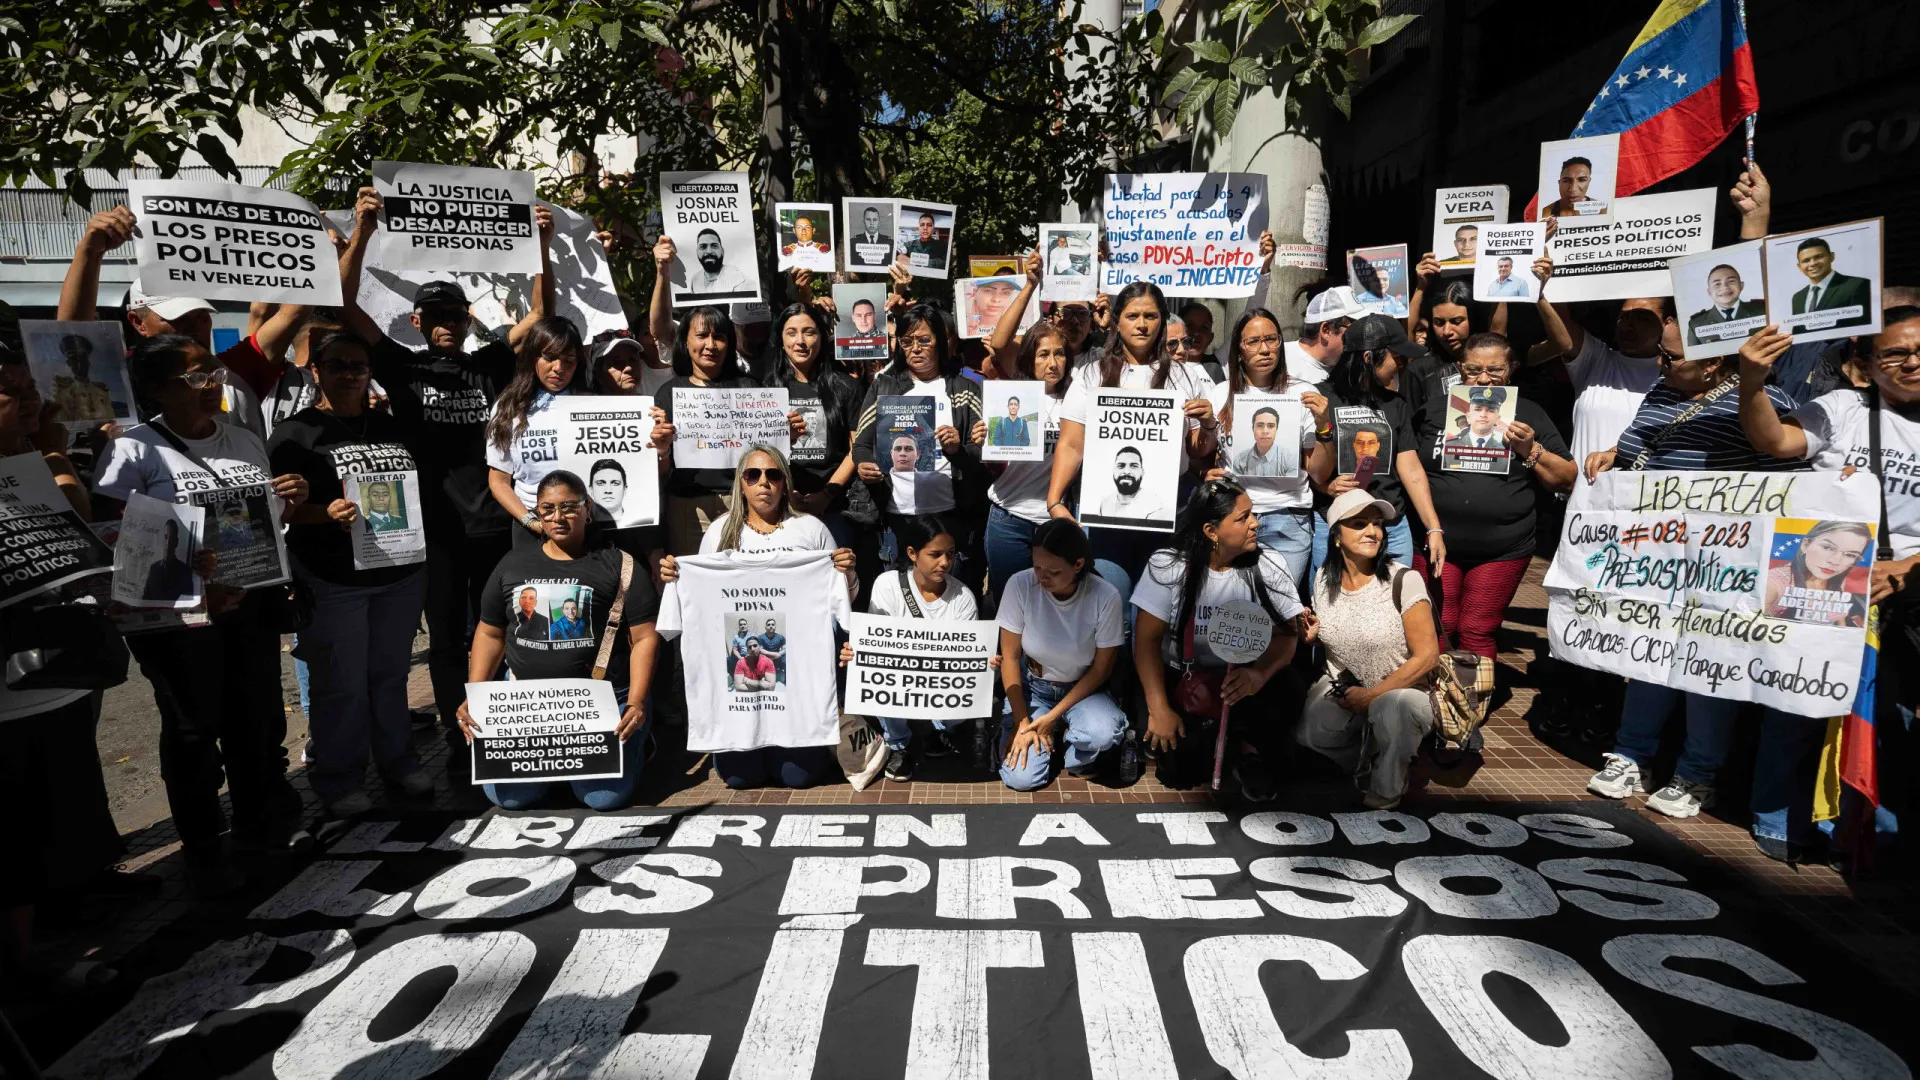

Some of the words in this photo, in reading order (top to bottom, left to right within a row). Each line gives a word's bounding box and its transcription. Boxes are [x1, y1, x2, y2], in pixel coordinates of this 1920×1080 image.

[397, 182, 424, 197] LA
[428, 184, 514, 202] JUSTICIA
[1112, 182, 1163, 201] Libertad
[1171, 189, 1202, 209] para
[1214, 184, 1233, 198] los
[1240, 186, 1251, 198] 4
[1445, 190, 1494, 200] JACKSON
[410, 200, 440, 214] NO
[446, 202, 510, 218] PUEDE
[676, 197, 738, 209] JOSNAR
[1445, 200, 1494, 214] VERA
[145, 199, 190, 214] SON
[196, 202, 239, 219] MÁS
[244, 207, 271, 222] DE
[274, 210, 320, 228] 1.000
[678, 212, 739, 224] BADUEL
[1106, 204, 1166, 226] choferes
[1177, 203, 1242, 220] acusados
[390, 216, 530, 236] DESAPARECER
[1614, 222, 1622, 230] A
[1626, 218, 1672, 229] TODOS
[1676, 214, 1701, 224] LOS
[151, 220, 206, 240] LOS
[214, 226, 316, 250] PRESOS
[1106, 223, 1197, 248] injustamente
[1206, 230, 1223, 240] en
[1230, 225, 1244, 241] el
[1487, 230, 1534, 238] ROBERTO
[1554, 236, 1610, 249] PRESOS
[1615, 227, 1702, 244] POLÍTICOS!
[412, 235, 514, 251] PERSONAS
[1487, 238, 1534, 247] VERNET
[156, 242, 316, 272] POLÍTICOS
[1108, 252, 1138, 262] caso
[1564, 252, 1596, 262] ¡CESE
[1598, 250, 1612, 258] LA
[1616, 244, 1687, 257] REPRESIÓN!
[169, 268, 196, 282] EN
[201, 270, 315, 290] VENEZUELA
[1148, 273, 1172, 285] son
[1176, 266, 1261, 286] INOCENTES
[1783, 314, 1812, 324] Leonardo
[676, 392, 686, 400] NI
[1100, 398, 1144, 406] LIBERTAD
[1146, 399, 1171, 408] PARA
[736, 400, 778, 409] LIBERTAD
[571, 412, 614, 420] LIBERTAD
[676, 411, 698, 419] PARA
[704, 410, 728, 419] JUAN
[730, 410, 753, 420] PABLO
[1099, 410, 1170, 426] JOSNAR
[576, 423, 640, 440] JESÚS
[1098, 426, 1168, 442] BADUEL
[330, 444, 370, 454] LIBEREN
[522, 438, 546, 449] LOS
[574, 440, 642, 454] ARMAS
[697, 440, 742, 450] LIBERTAD
[333, 452, 363, 464] LOS
[1906, 453, 1916, 462] A
[221, 468, 230, 476] A
[1460, 461, 1490, 470] LIBERTAD
[356, 474, 406, 482] LIBERTAD
[174, 480, 210, 492] LOS
[194, 486, 264, 505] LIBERTAD
[4, 514, 70, 532] VIOLENCIA
[1568, 513, 1620, 546] Causa
[4, 530, 58, 548] CONTRA
[57, 527, 81, 542] LAS
[24, 545, 49, 560] DE
[46, 538, 92, 556] PRESOS
[1, 554, 80, 587] POLÍTICOS
[722, 588, 740, 598] NO
[742, 587, 786, 598] SOMOS
[1784, 586, 1852, 603] LIBERTAD
[734, 601, 774, 612] PDVSA
[905, 594, 920, 617] GUESS
[1778, 596, 1854, 614] ADELMARY
[1232, 611, 1245, 621] de
[1248, 614, 1270, 626] Vida
[1795, 608, 1830, 622] LEAL
[868, 626, 893, 638] LOS
[896, 630, 976, 642] FAMILIARES
[1218, 622, 1242, 634] Para
[1244, 626, 1263, 638] Los
[552, 641, 575, 650] RAINER
[858, 638, 909, 650] SEGUIMOS
[912, 643, 972, 652] ESPERANDO
[1208, 631, 1266, 652] GEDEONES
[857, 654, 919, 668] LIBERTAD
[922, 660, 940, 670] DE
[942, 660, 986, 670] TODOS
[860, 670, 896, 687] LOS
[902, 674, 977, 690] PRESOS
[490, 692, 507, 702] NO
[510, 690, 536, 701] HAY
[538, 688, 591, 700] NÚMERO
[735, 694, 778, 703] LIBERTAD
[860, 689, 974, 708] POLÍTICOS
[488, 700, 575, 714] SIGNIFICATIVO
[578, 699, 594, 708] DE
[728, 704, 750, 712] PARA
[752, 703, 762, 712] MI
[764, 704, 785, 712] HIJO
[485, 710, 600, 726] EXCARCELACIONES
[496, 728, 512, 737] EN
[515, 724, 586, 736] VENEZUELA
[484, 739, 516, 749] PERO
[518, 737, 528, 748] SÍ
[531, 737, 549, 748] UN
[552, 734, 606, 746] NÚMERO
[486, 749, 546, 760] DOLOROSO
[548, 748, 563, 757] DE
[565, 745, 609, 756] PRESOS
[512, 758, 584, 772] POLÍTICOS
[325, 814, 967, 853] LIBEREN
[1018, 812, 1110, 846] A
[1136, 810, 1634, 848] TODOS
[248, 852, 722, 920] LOS
[778, 853, 1720, 921] PRESOS
[47, 912, 1912, 1080] POLÍTICOS
